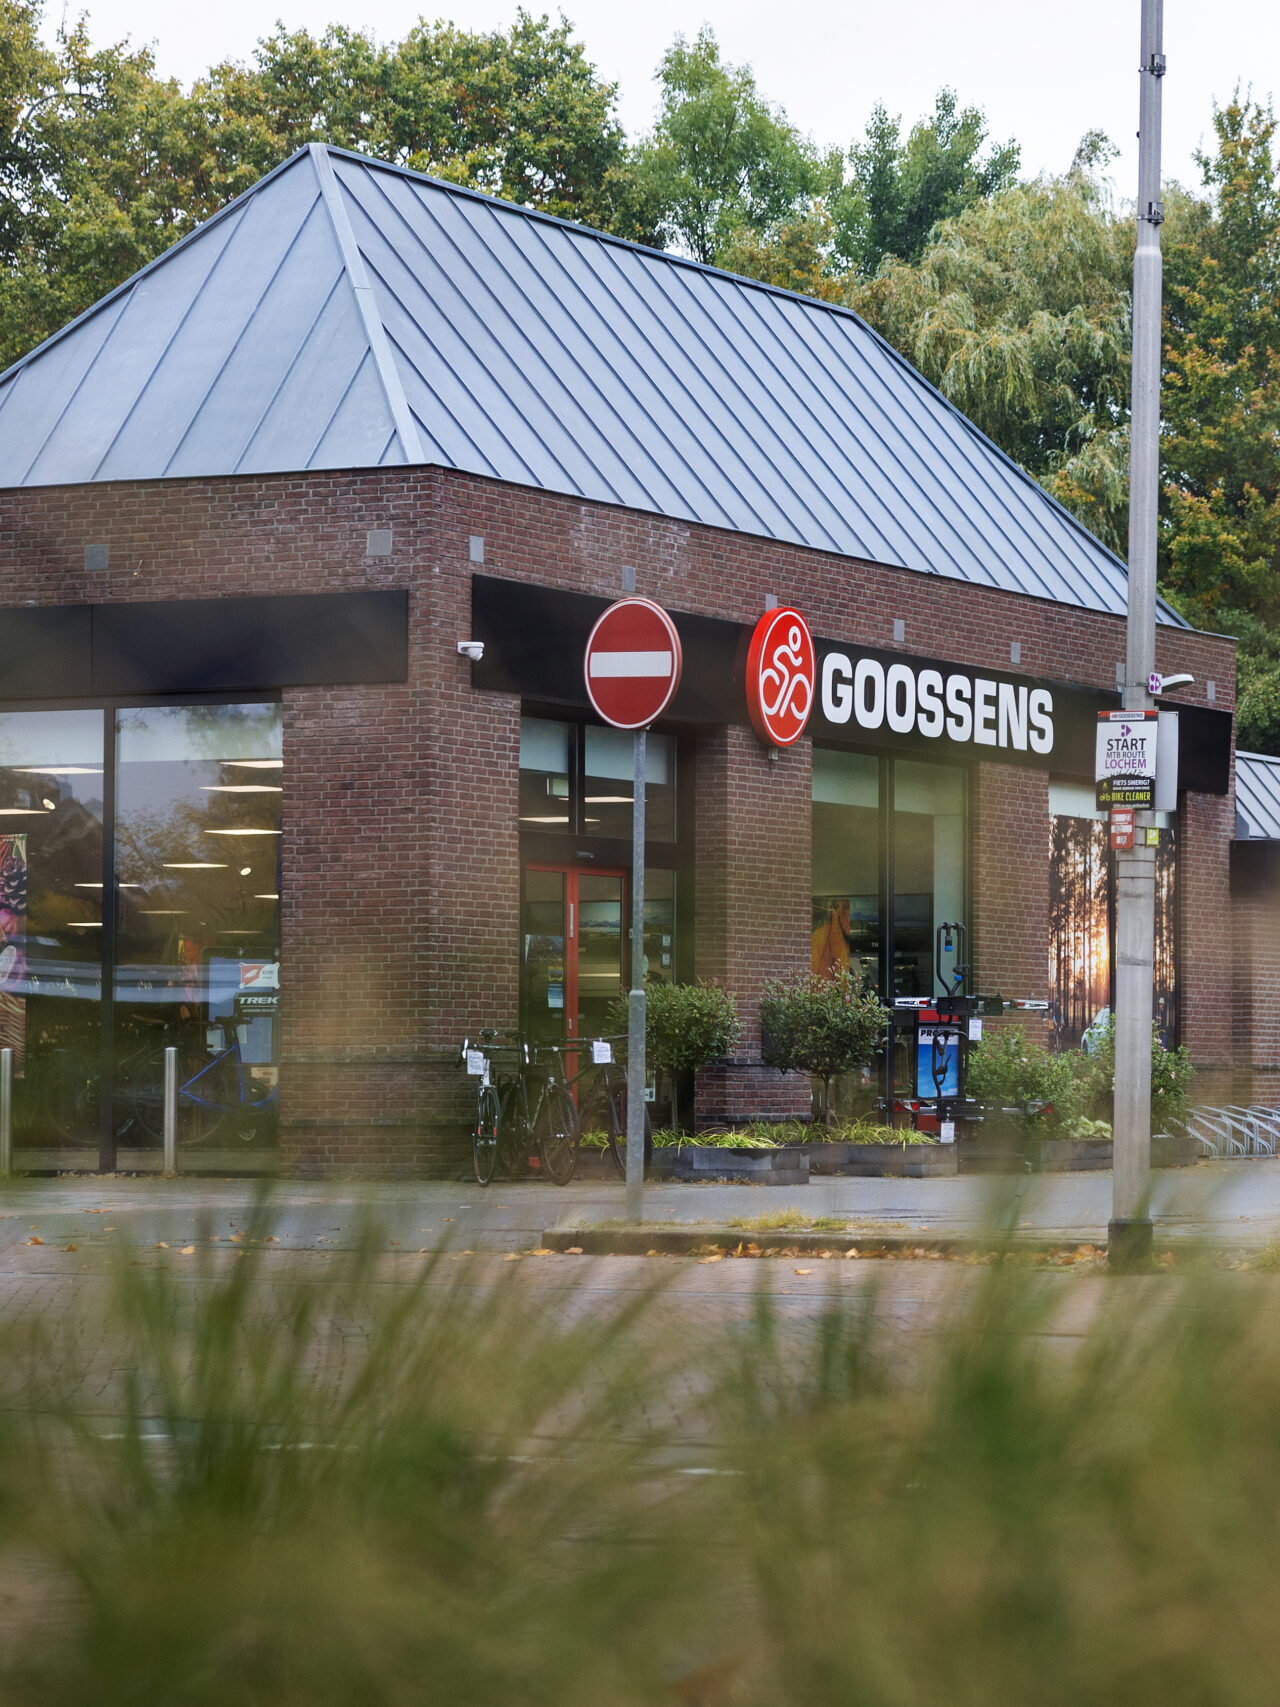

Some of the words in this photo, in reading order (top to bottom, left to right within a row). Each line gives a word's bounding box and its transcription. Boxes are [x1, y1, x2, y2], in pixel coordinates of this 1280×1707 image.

[821, 652, 1055, 754] GOOSSENS
[1107, 738, 1147, 751] START
[1105, 758, 1147, 769] LOCHEM
[1112, 792, 1124, 801] BIKE
[1126, 792, 1150, 800] CLEANER
